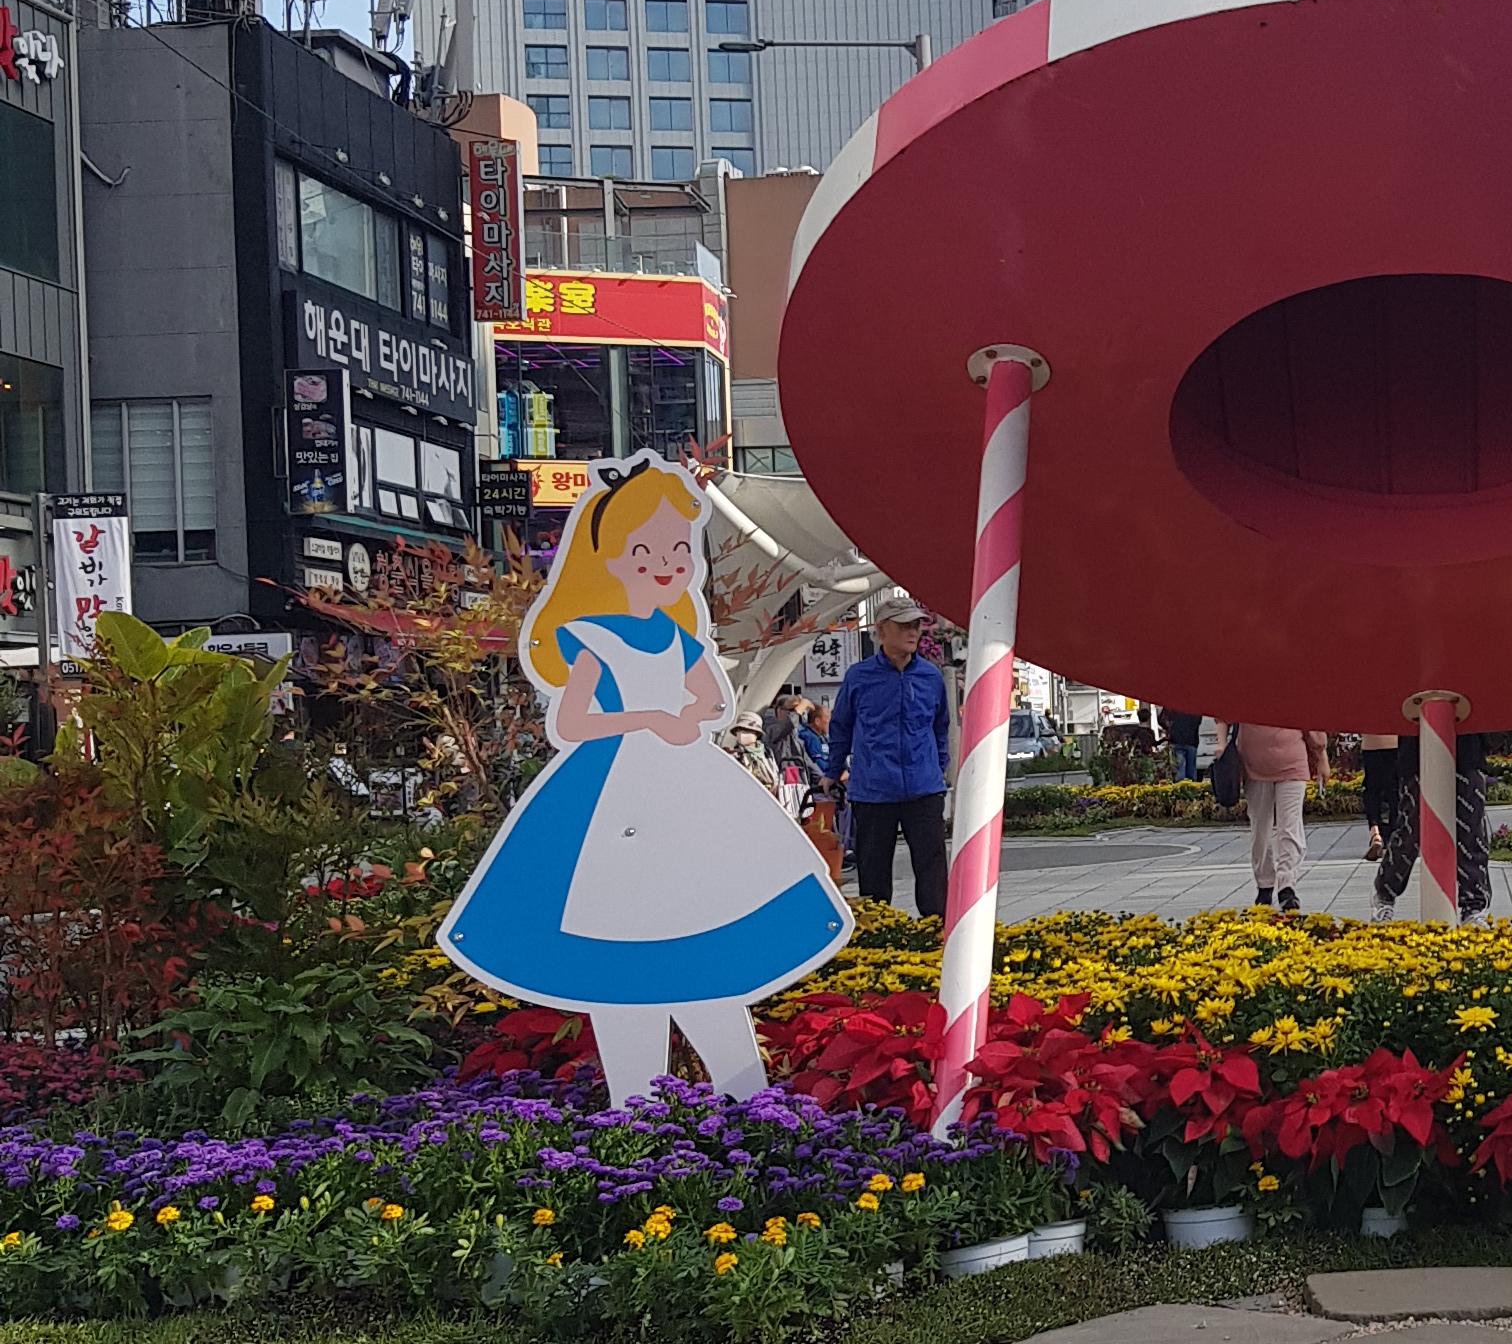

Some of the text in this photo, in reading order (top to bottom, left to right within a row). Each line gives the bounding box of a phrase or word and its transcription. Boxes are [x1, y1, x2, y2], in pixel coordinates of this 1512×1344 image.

[478, 157, 512, 309] 타이마사지
[412, 290, 448, 324] 741 1144
[304, 299, 473, 408] 해운대 타이마사지
[295, 451, 329, 464] 맛있는
[483, 487, 526, 500] 24시간
